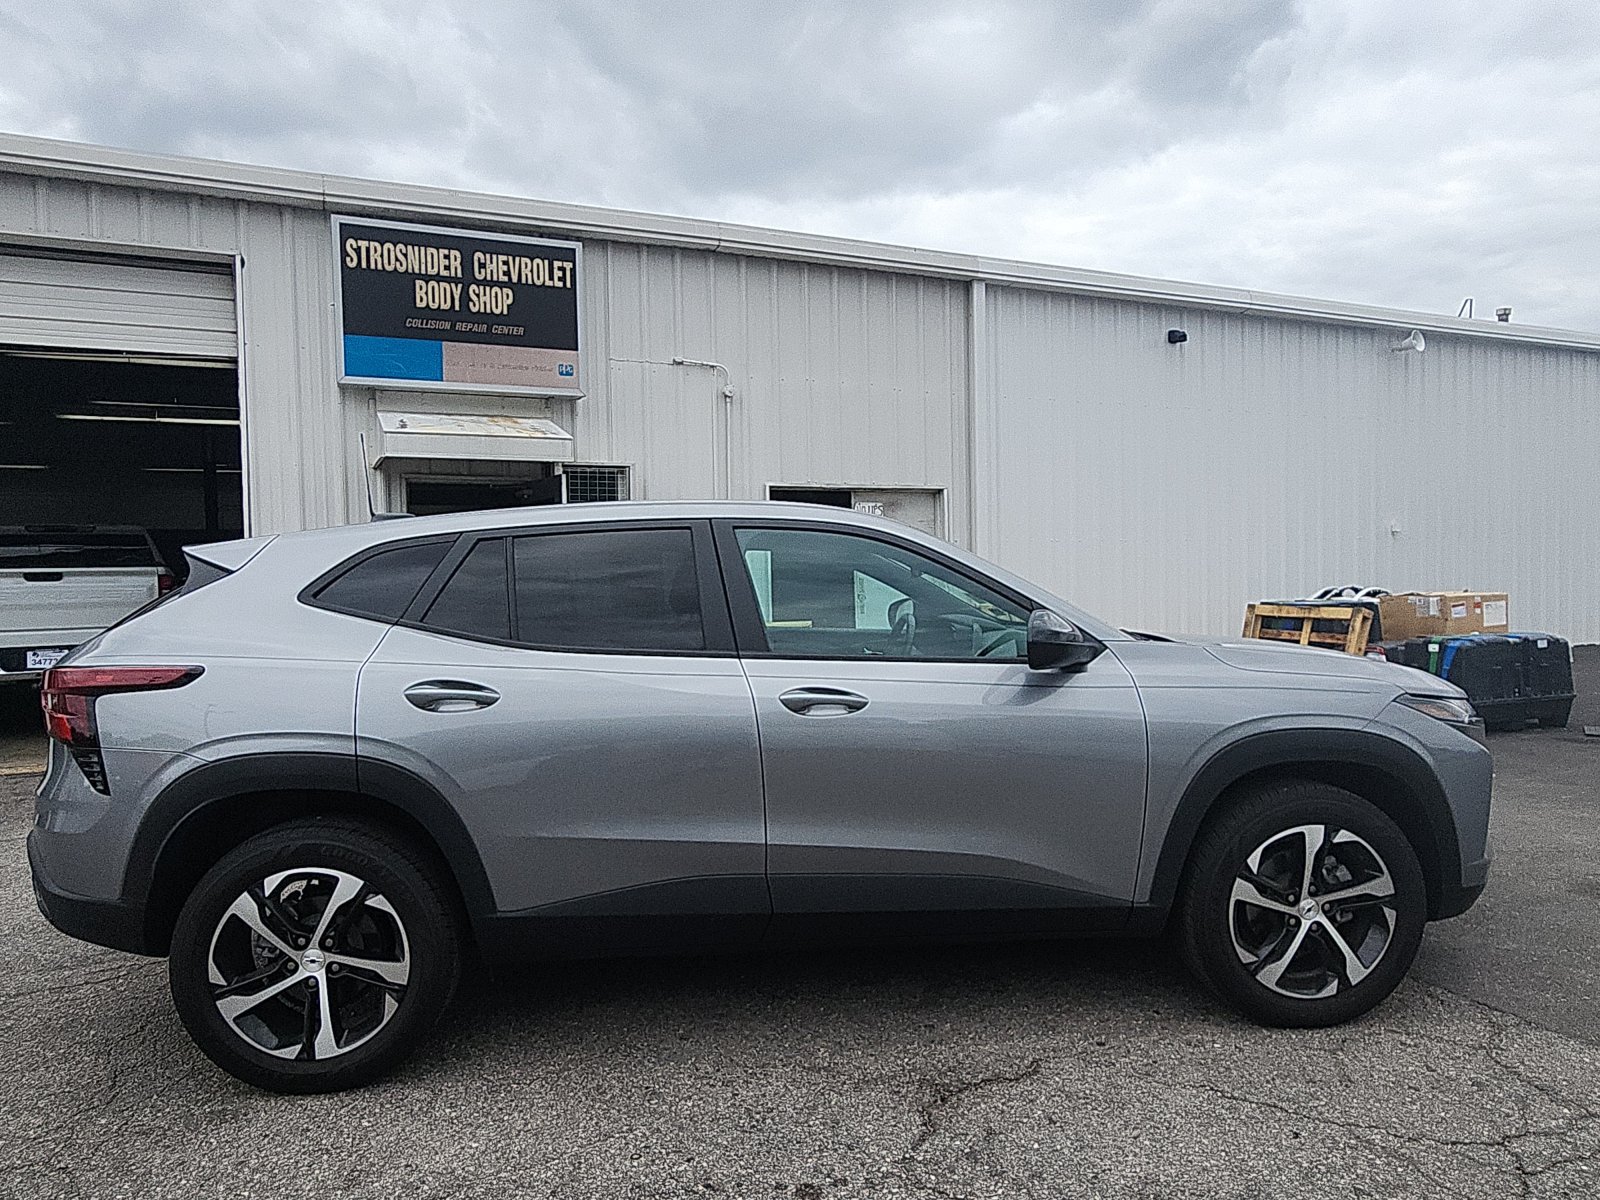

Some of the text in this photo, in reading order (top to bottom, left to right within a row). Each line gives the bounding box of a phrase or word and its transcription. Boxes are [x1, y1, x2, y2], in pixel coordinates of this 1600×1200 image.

[345, 238, 573, 288] STROSNIDER CHEVROLET
[415, 279, 514, 315] BODY SHOP
[405, 318, 524, 336] COLLISION REPAIR CENTER
